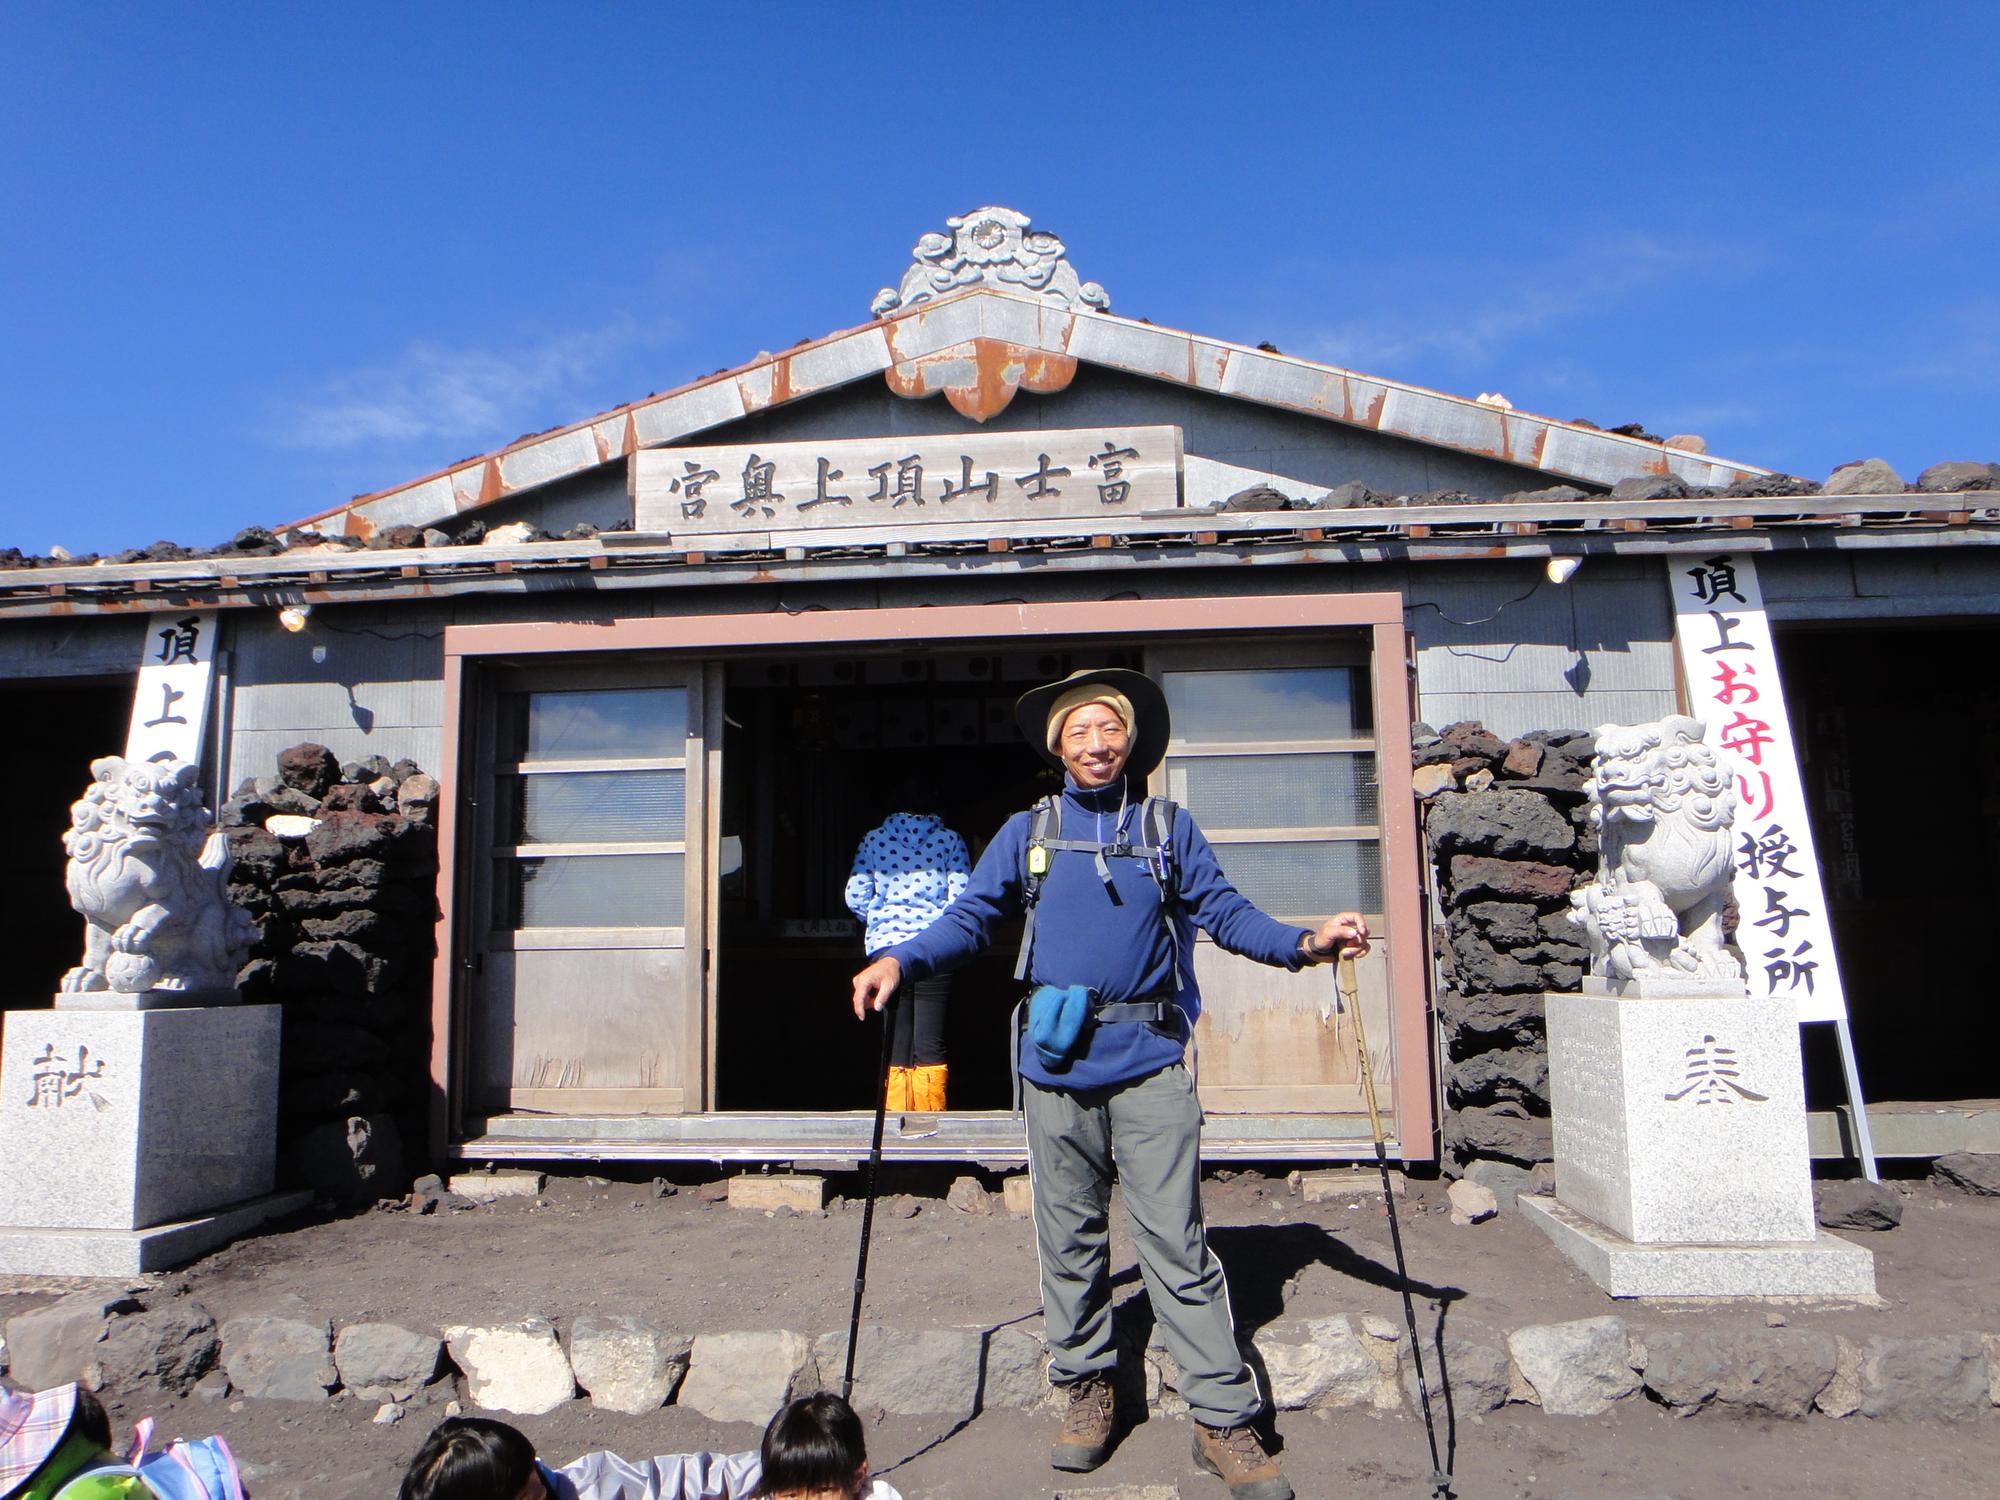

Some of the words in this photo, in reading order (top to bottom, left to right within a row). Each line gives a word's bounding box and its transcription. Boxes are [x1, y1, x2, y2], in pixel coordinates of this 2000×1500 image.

[143, 616, 201, 762] 頂上
[1686, 554, 1819, 998] 頂上お守り授与所
[1664, 1035, 1770, 1105] 奉
